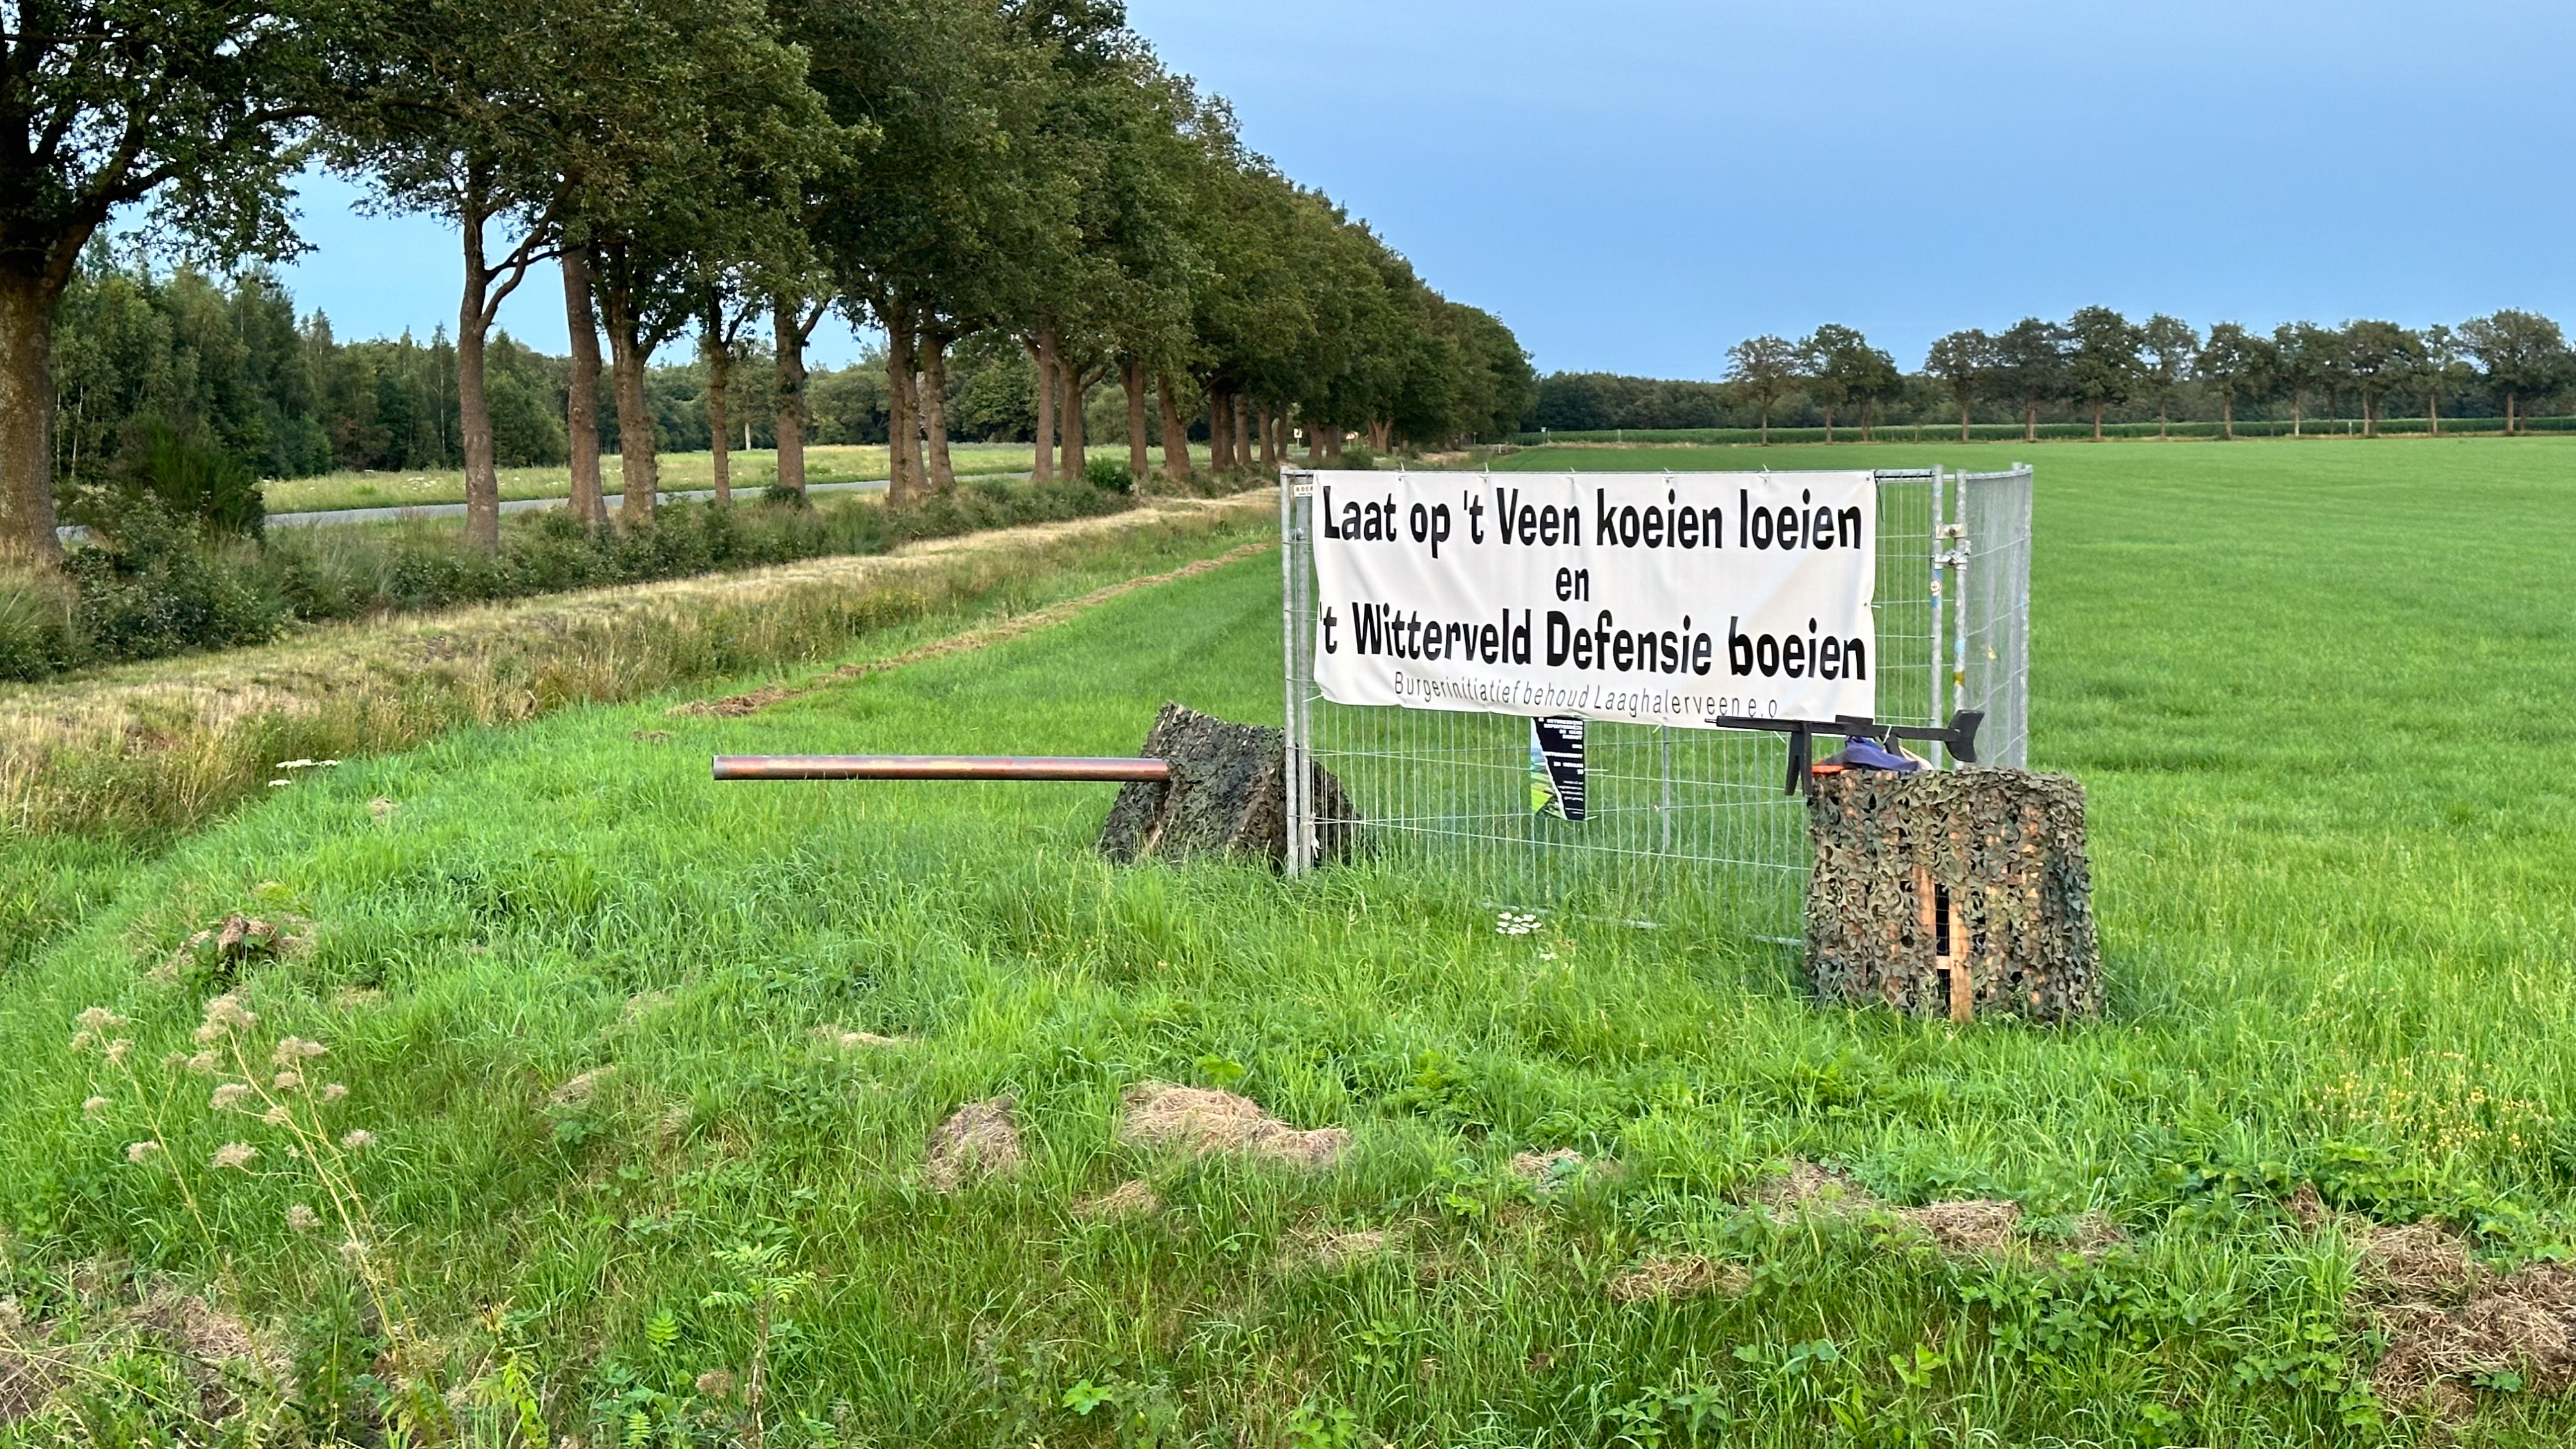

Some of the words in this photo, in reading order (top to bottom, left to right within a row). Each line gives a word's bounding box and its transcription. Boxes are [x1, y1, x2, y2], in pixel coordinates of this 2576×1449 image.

[1323, 486, 1397, 542] Laat
[1410, 502, 1451, 559] op
[1496, 488, 1580, 547] Veen
[1596, 488, 1723, 549] koeien
[1739, 488, 1862, 551] loeien
[1555, 567, 1589, 602] en
[1351, 601, 1531, 665] Witterveld
[1546, 609, 1712, 676] Defensie
[1728, 616, 1866, 681] boeien
[1394, 671, 1520, 704] Burgerinitiatief
[1523, 681, 1589, 708] behoud
[1593, 685, 1739, 717] Laaghalerveen
